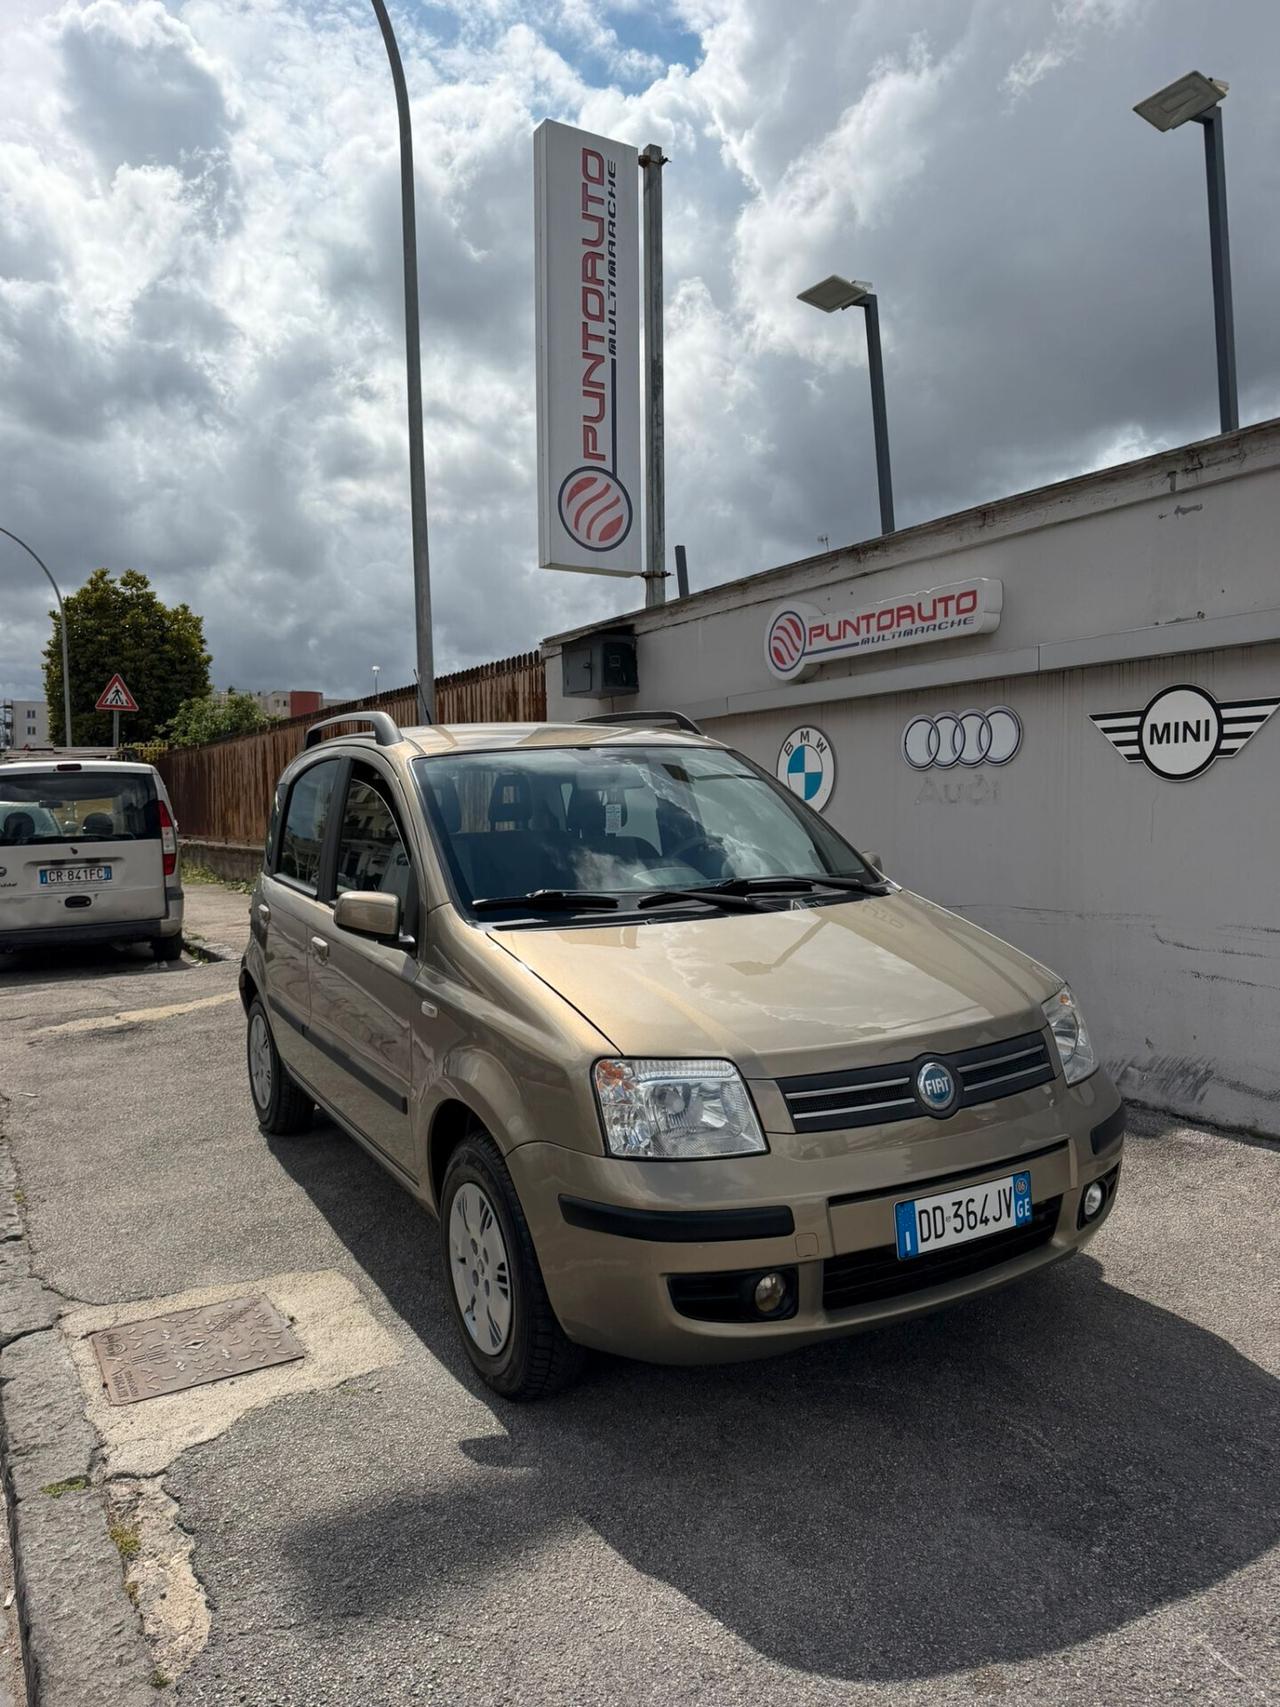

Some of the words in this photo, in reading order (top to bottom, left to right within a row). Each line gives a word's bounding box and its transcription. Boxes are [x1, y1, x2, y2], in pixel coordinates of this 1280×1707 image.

[606, 159, 617, 356] MULTIMARCHE
[581, 147, 606, 462] PUNTOAUTO
[808, 589, 977, 646] PUNTOAUTO
[860, 615, 975, 646] MULTIMARCHE
[783, 730, 828, 757] BMW
[1149, 718, 1211, 745] MINI
[925, 1076, 949, 1096] FIAT
[918, 1205, 946, 1243] DD
[951, 1186, 1013, 1234] 364JV
[1016, 1197, 1030, 1218] GE
